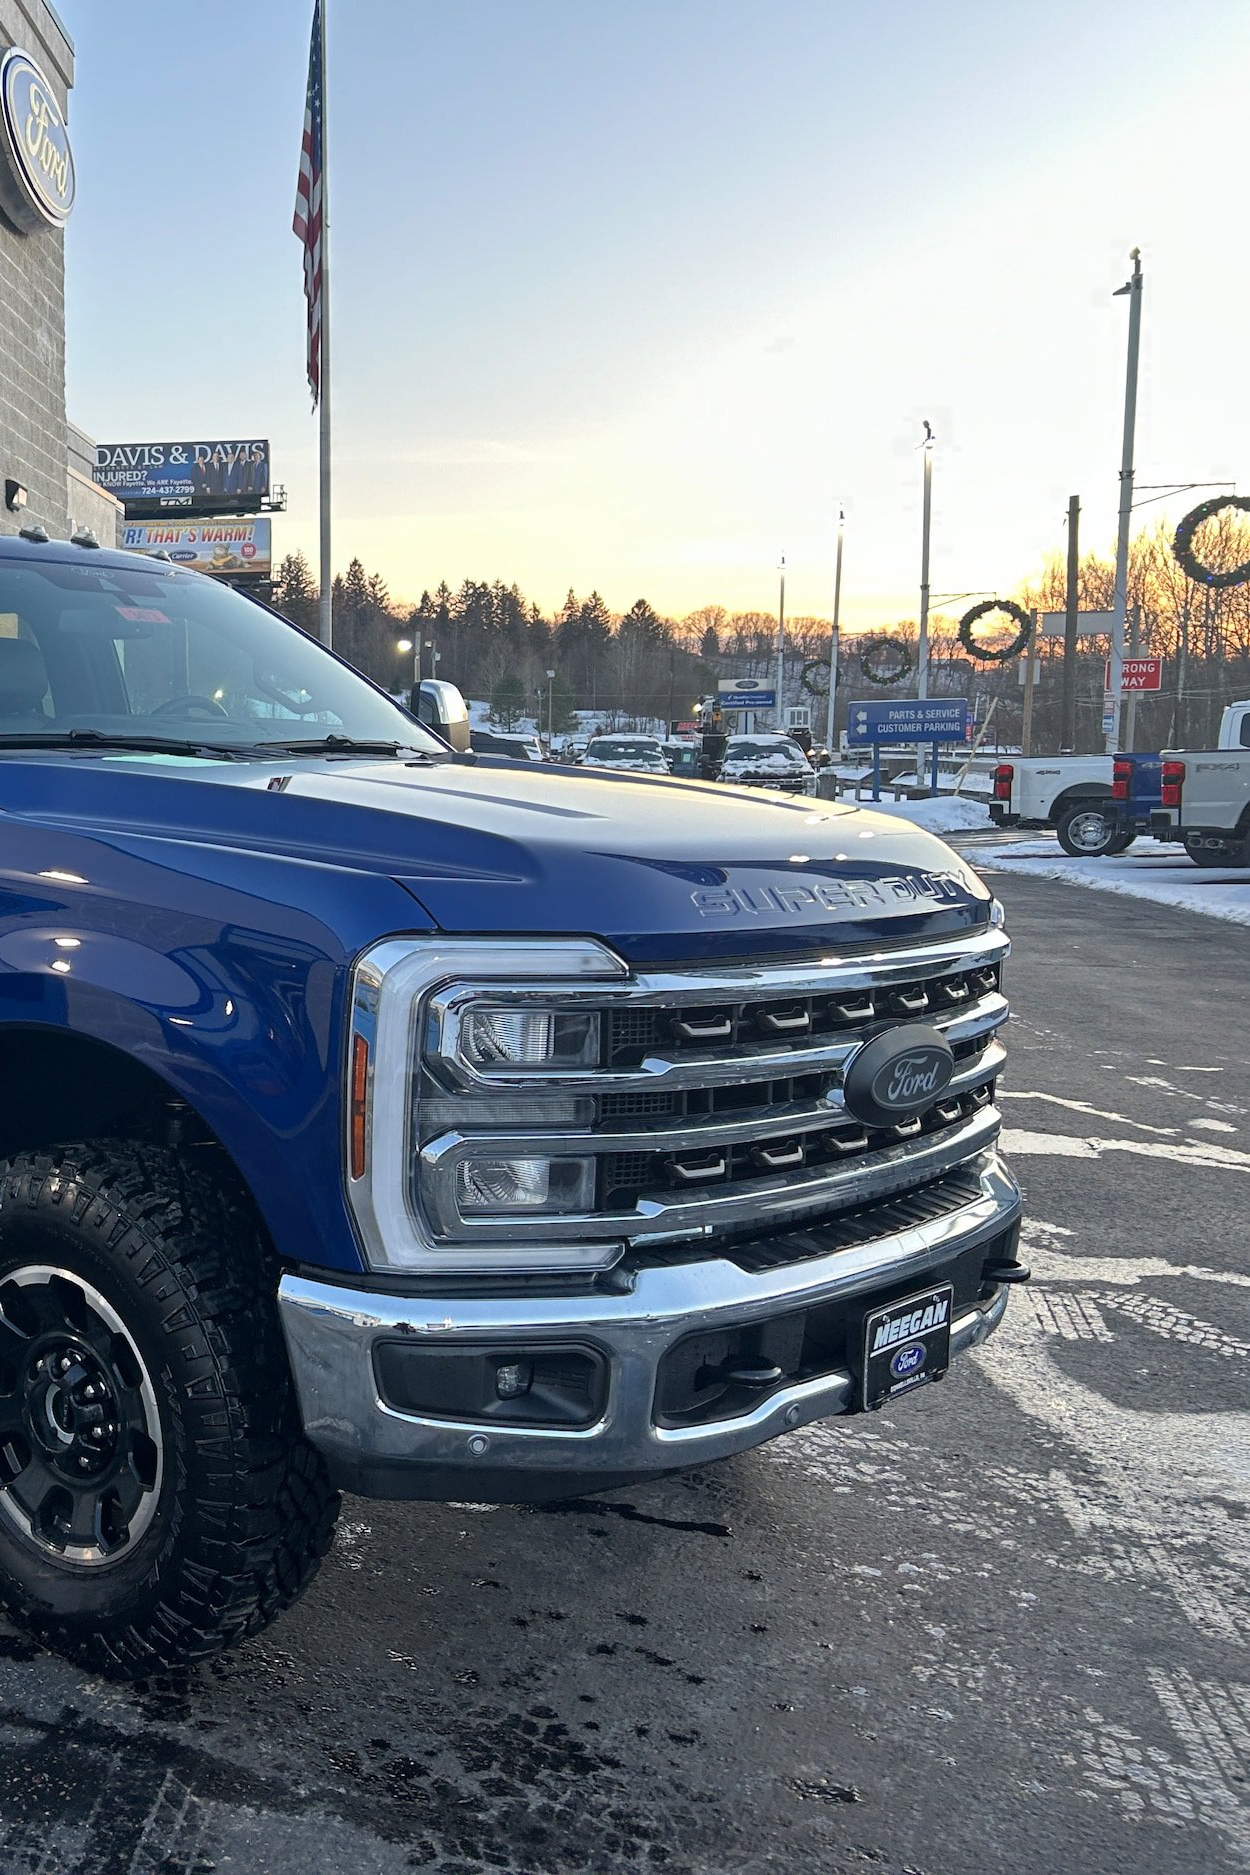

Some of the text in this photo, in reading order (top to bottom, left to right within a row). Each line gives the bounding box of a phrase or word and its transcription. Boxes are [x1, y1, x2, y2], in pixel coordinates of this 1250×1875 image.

[25, 82, 69, 198] Ford
[94, 442, 265, 467] DAVIS & DAVIS
[93, 470, 148, 482] INJURED?
[142, 486, 195, 495] 724-437-2799
[124, 526, 255, 544] R! THAT'S WARM!
[171, 552, 194, 560] Carrier
[1122, 663, 1156, 673] RONG
[1121, 677, 1146, 686] WAY
[889, 708, 960, 720] PARTS & SERVICE
[877, 722, 961, 734] CUSTOMER PARKING
[690, 870, 974, 917] SUPER DUTY
[887, 1055, 940, 1101] Ford
[873, 1299, 949, 1350] MEEGAN
[897, 1349, 920, 1372] Ford
